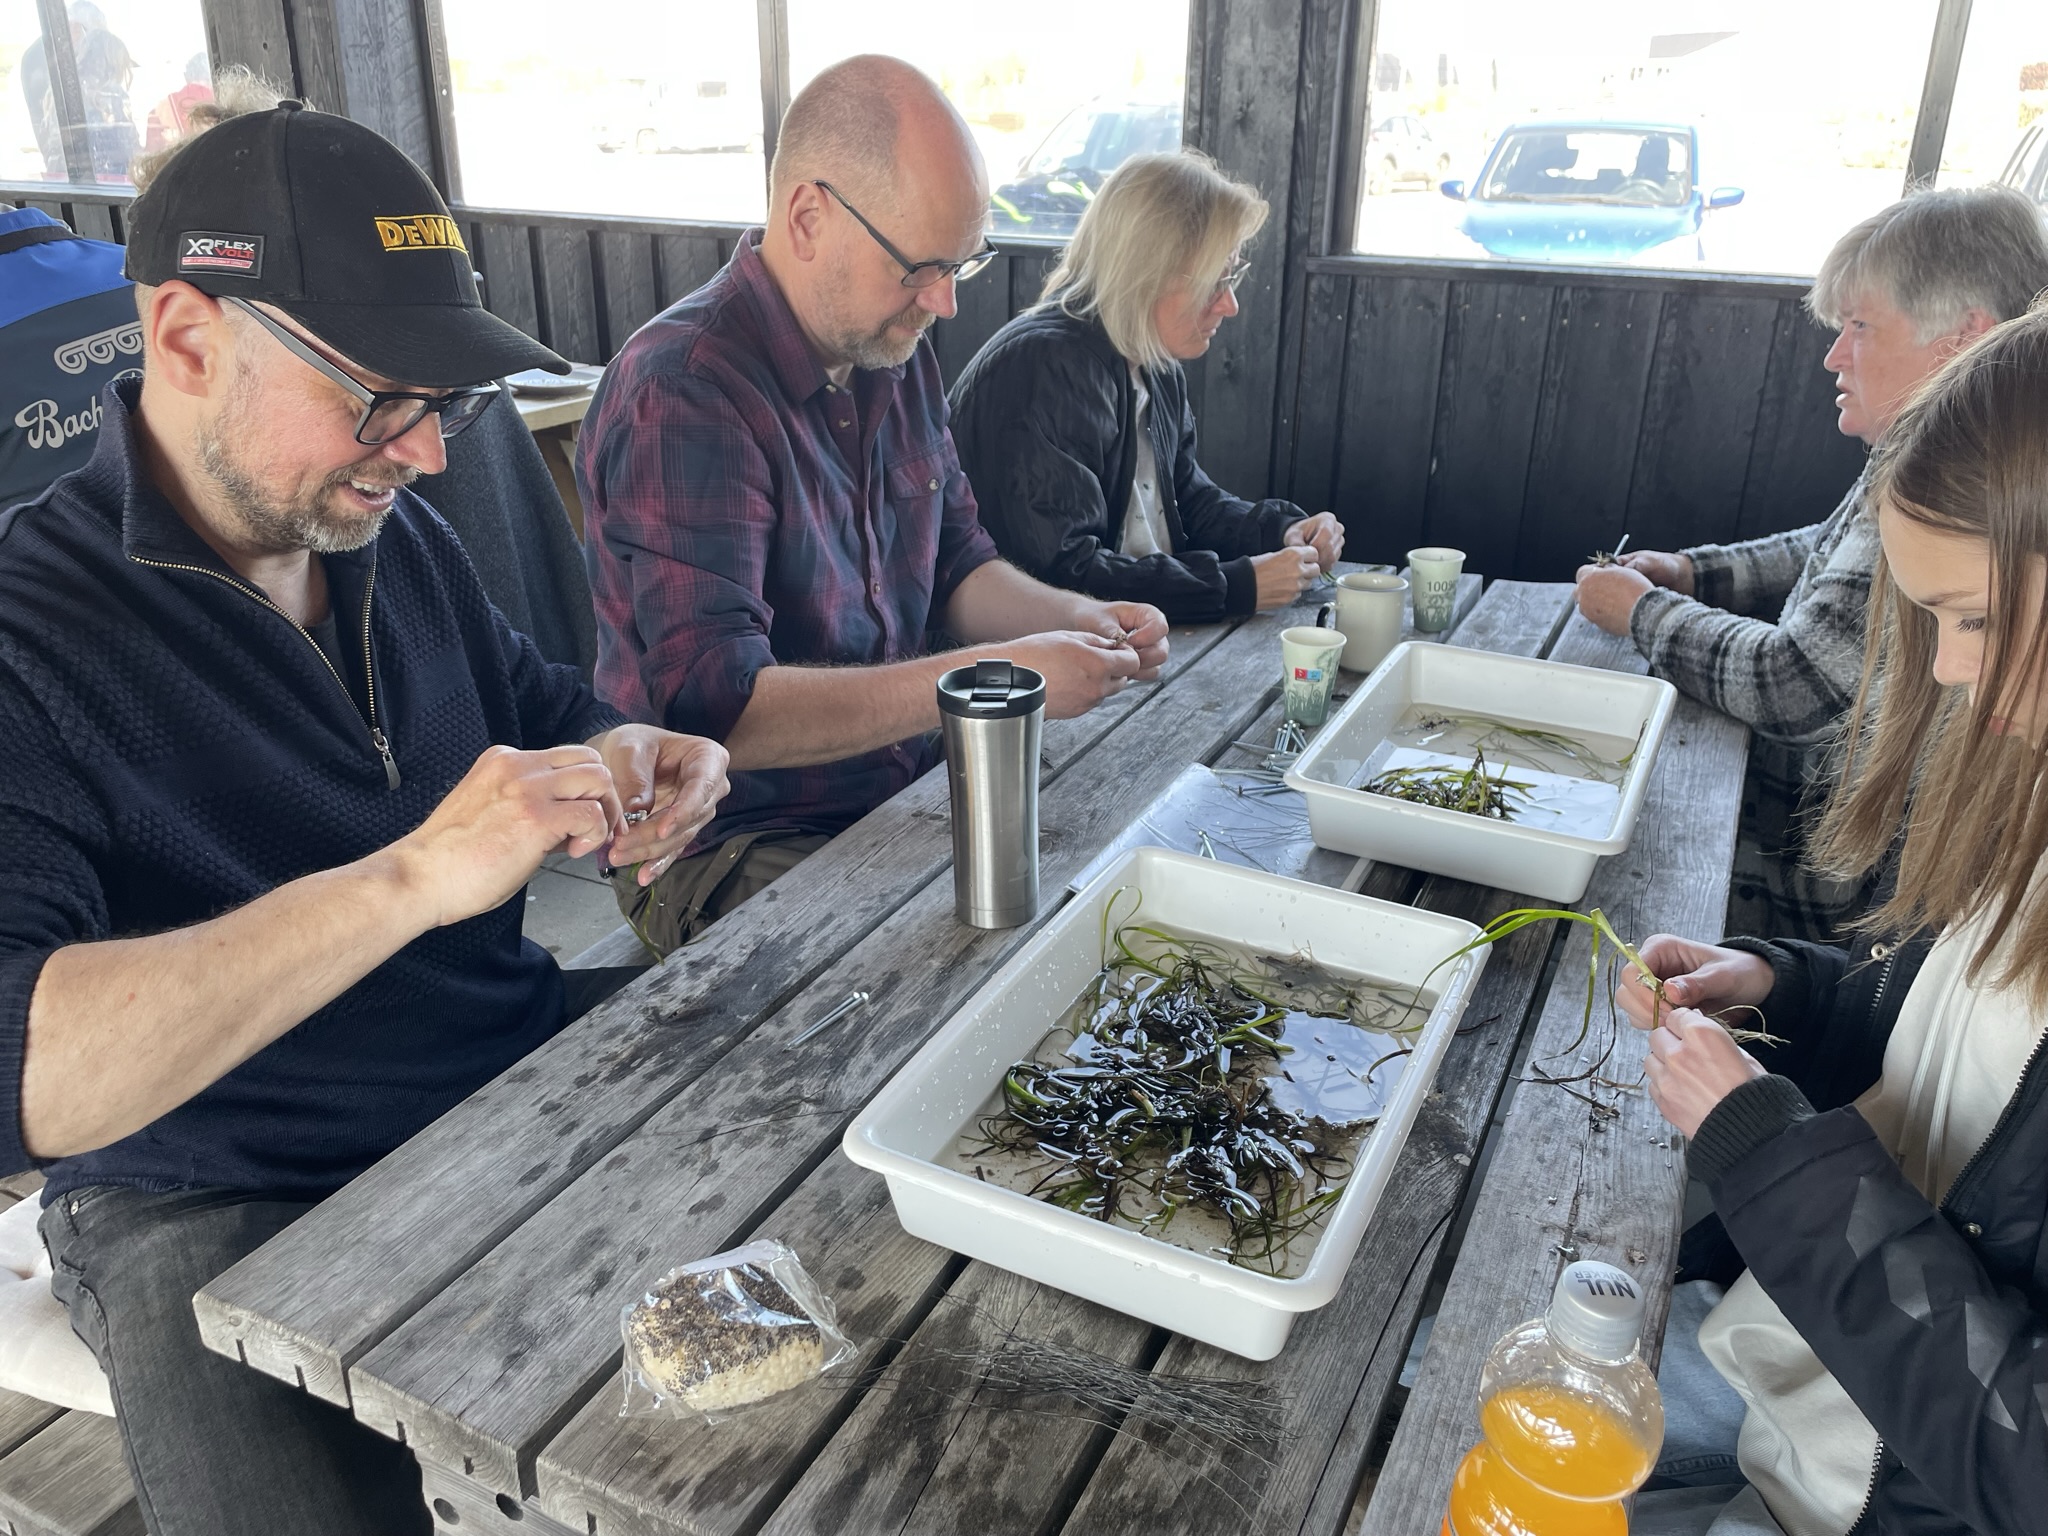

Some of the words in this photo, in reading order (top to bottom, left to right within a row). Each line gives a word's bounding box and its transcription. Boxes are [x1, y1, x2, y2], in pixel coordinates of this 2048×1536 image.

[186, 238, 214, 255] XR
[214, 239, 256, 252] FLEX
[214, 247, 256, 260] VOLT
[1574, 1270, 1628, 1282] SUKKER
[1577, 1278, 1637, 1299] NUL
